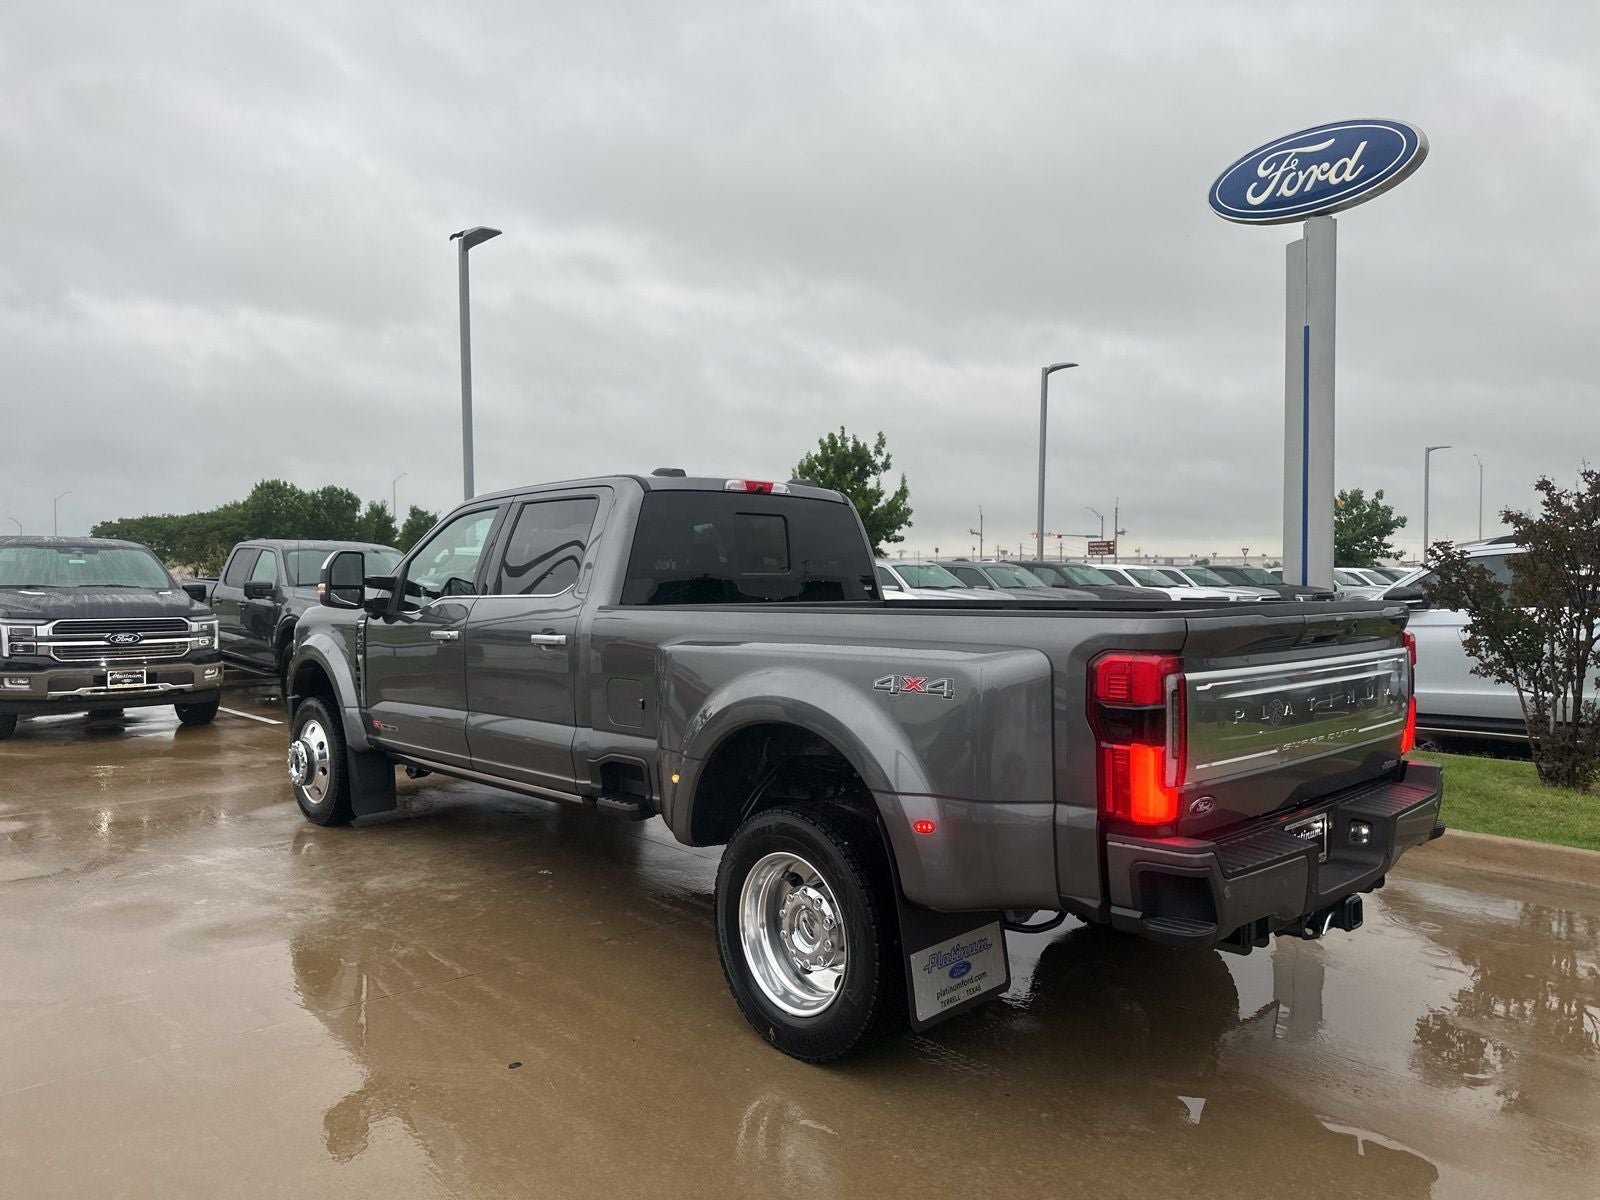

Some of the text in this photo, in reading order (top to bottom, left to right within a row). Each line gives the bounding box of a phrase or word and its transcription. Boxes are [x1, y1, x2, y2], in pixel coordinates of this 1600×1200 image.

[1246, 138, 1368, 205] Ford
[115, 634, 133, 642] Ford
[1233, 688, 1391, 725] PLATINUM
[922, 936, 993, 975] Platinum
[952, 964, 968, 977] Ford
[936, 971, 987, 1000] platinumford.com
[940, 984, 982, 1009] TERRELL TEXAS
